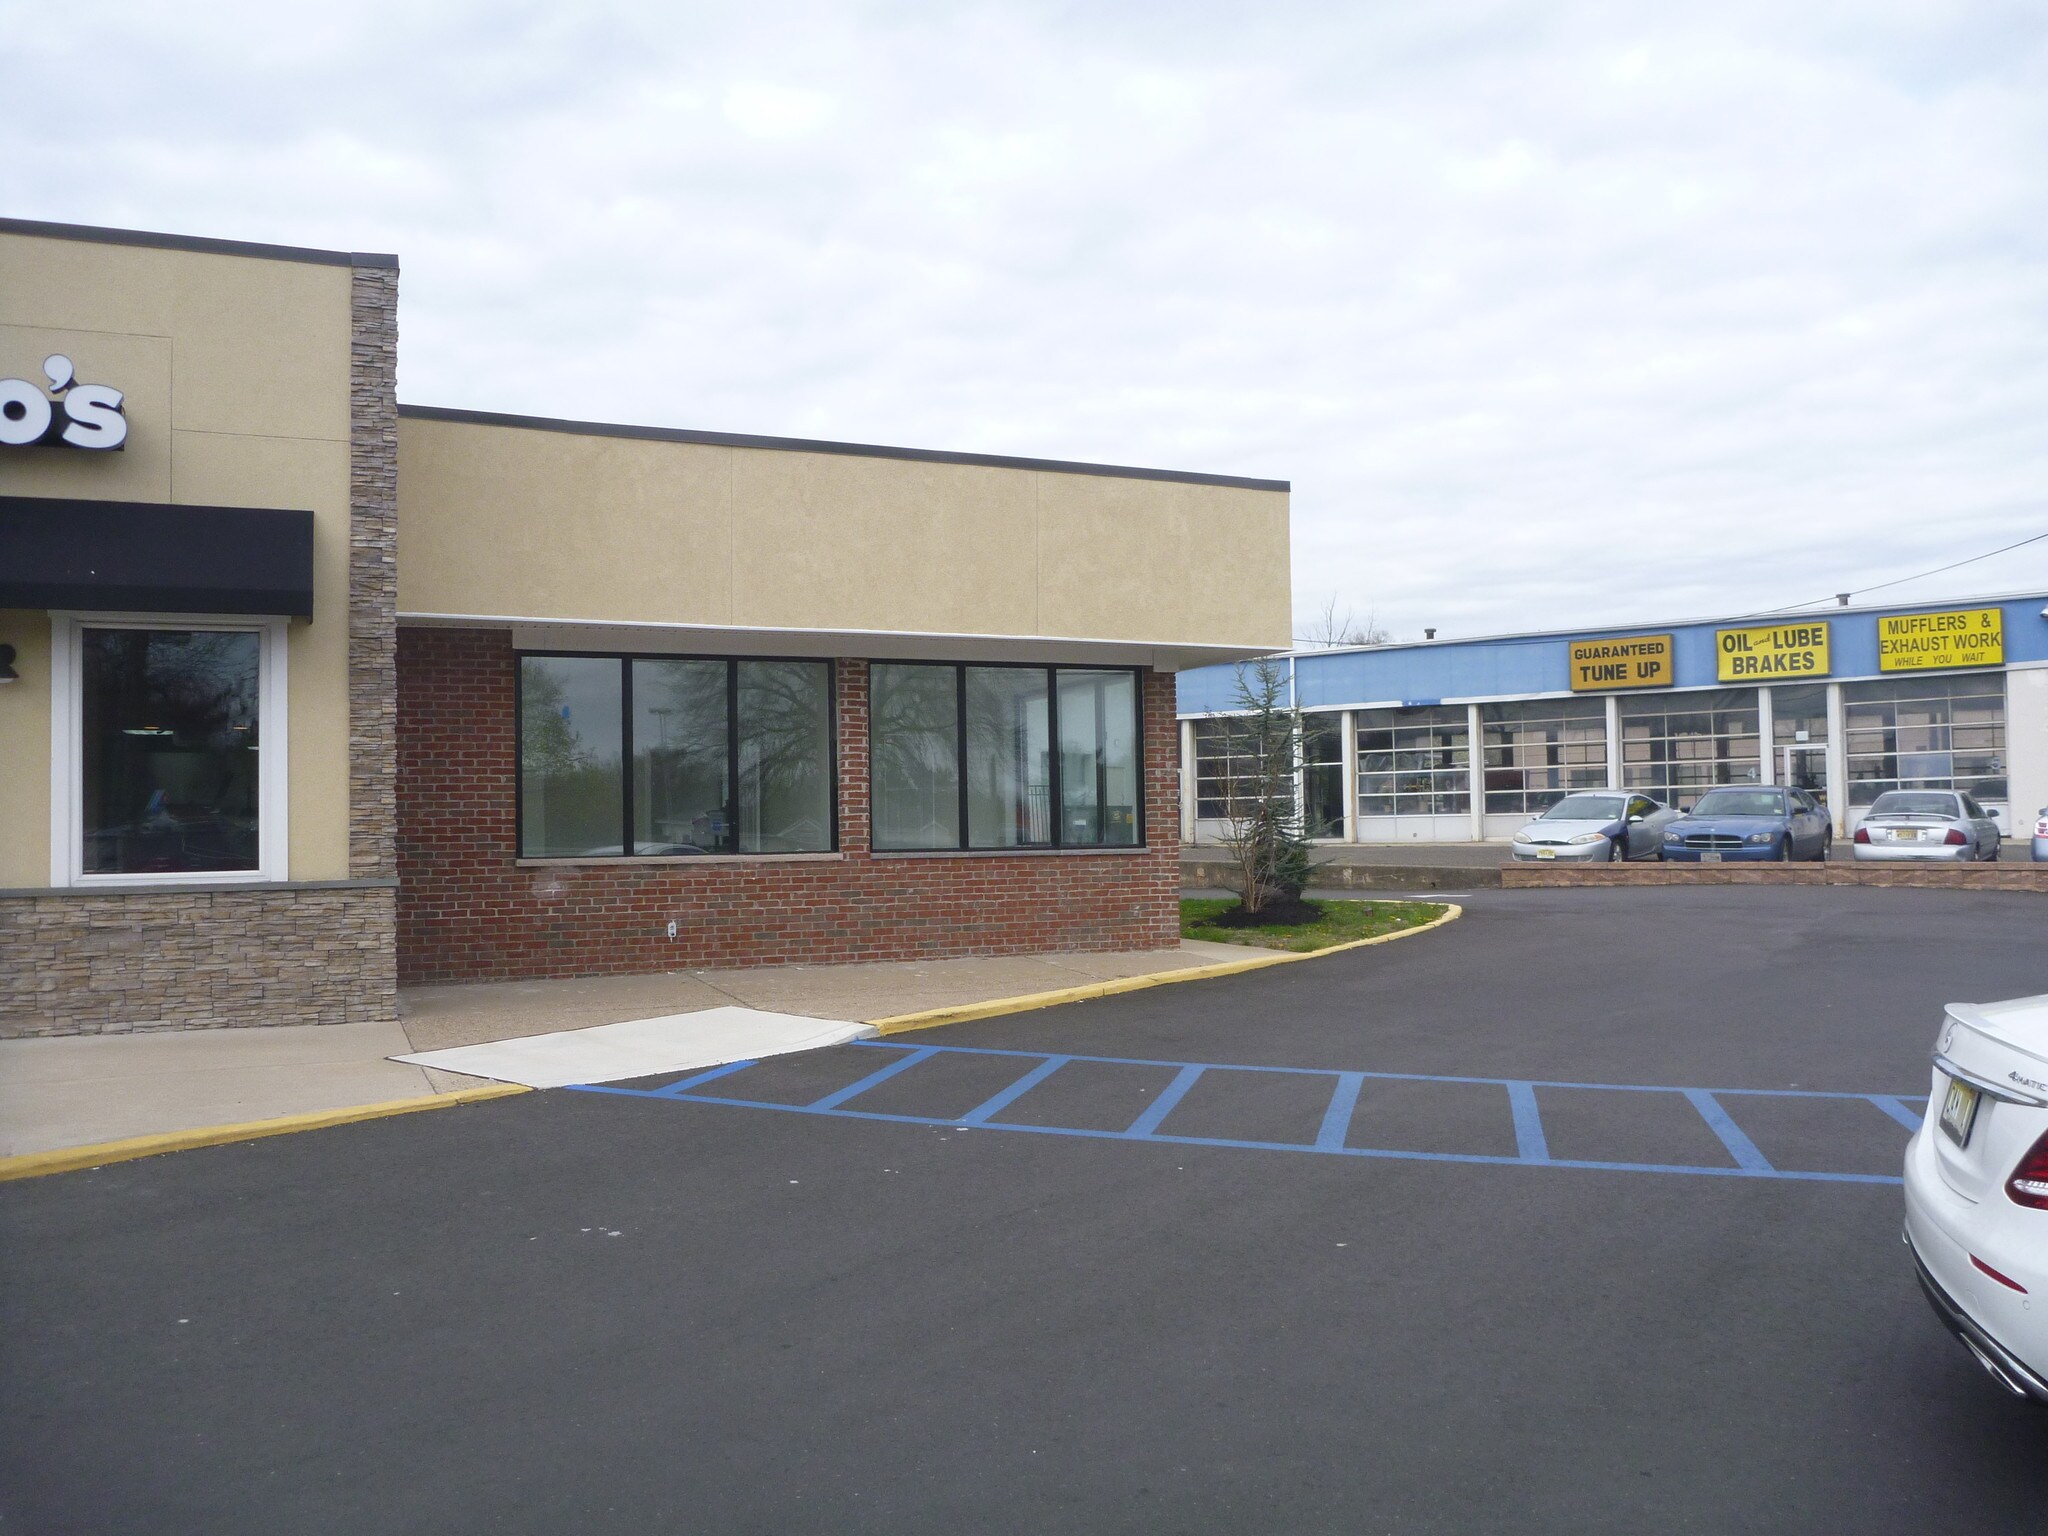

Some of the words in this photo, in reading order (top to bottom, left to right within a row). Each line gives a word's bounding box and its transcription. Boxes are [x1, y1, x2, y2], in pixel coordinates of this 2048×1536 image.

[1888, 615, 1967, 635] MUFFLERS
[1981, 613, 1991, 628] &
[1722, 634, 1753, 653] OIL
[1753, 633, 1771, 646] and
[1773, 627, 1823, 649] LUBE
[1881, 635, 1949, 654] EXHAUST
[1953, 632, 2002, 649] WORK
[1574, 642, 1665, 660] GUARANTEED
[1894, 656, 1924, 667] WHILE
[1933, 654, 1953, 665] YOU
[1961, 652, 1986, 663] WAIT
[1580, 663, 1627, 682] TUNE
[1637, 661, 1661, 678] UP
[1732, 651, 1815, 675] BRAKES
[1747, 767, 1756, 779] 4
[2008, 1071, 2048, 1092] 4MATIC
